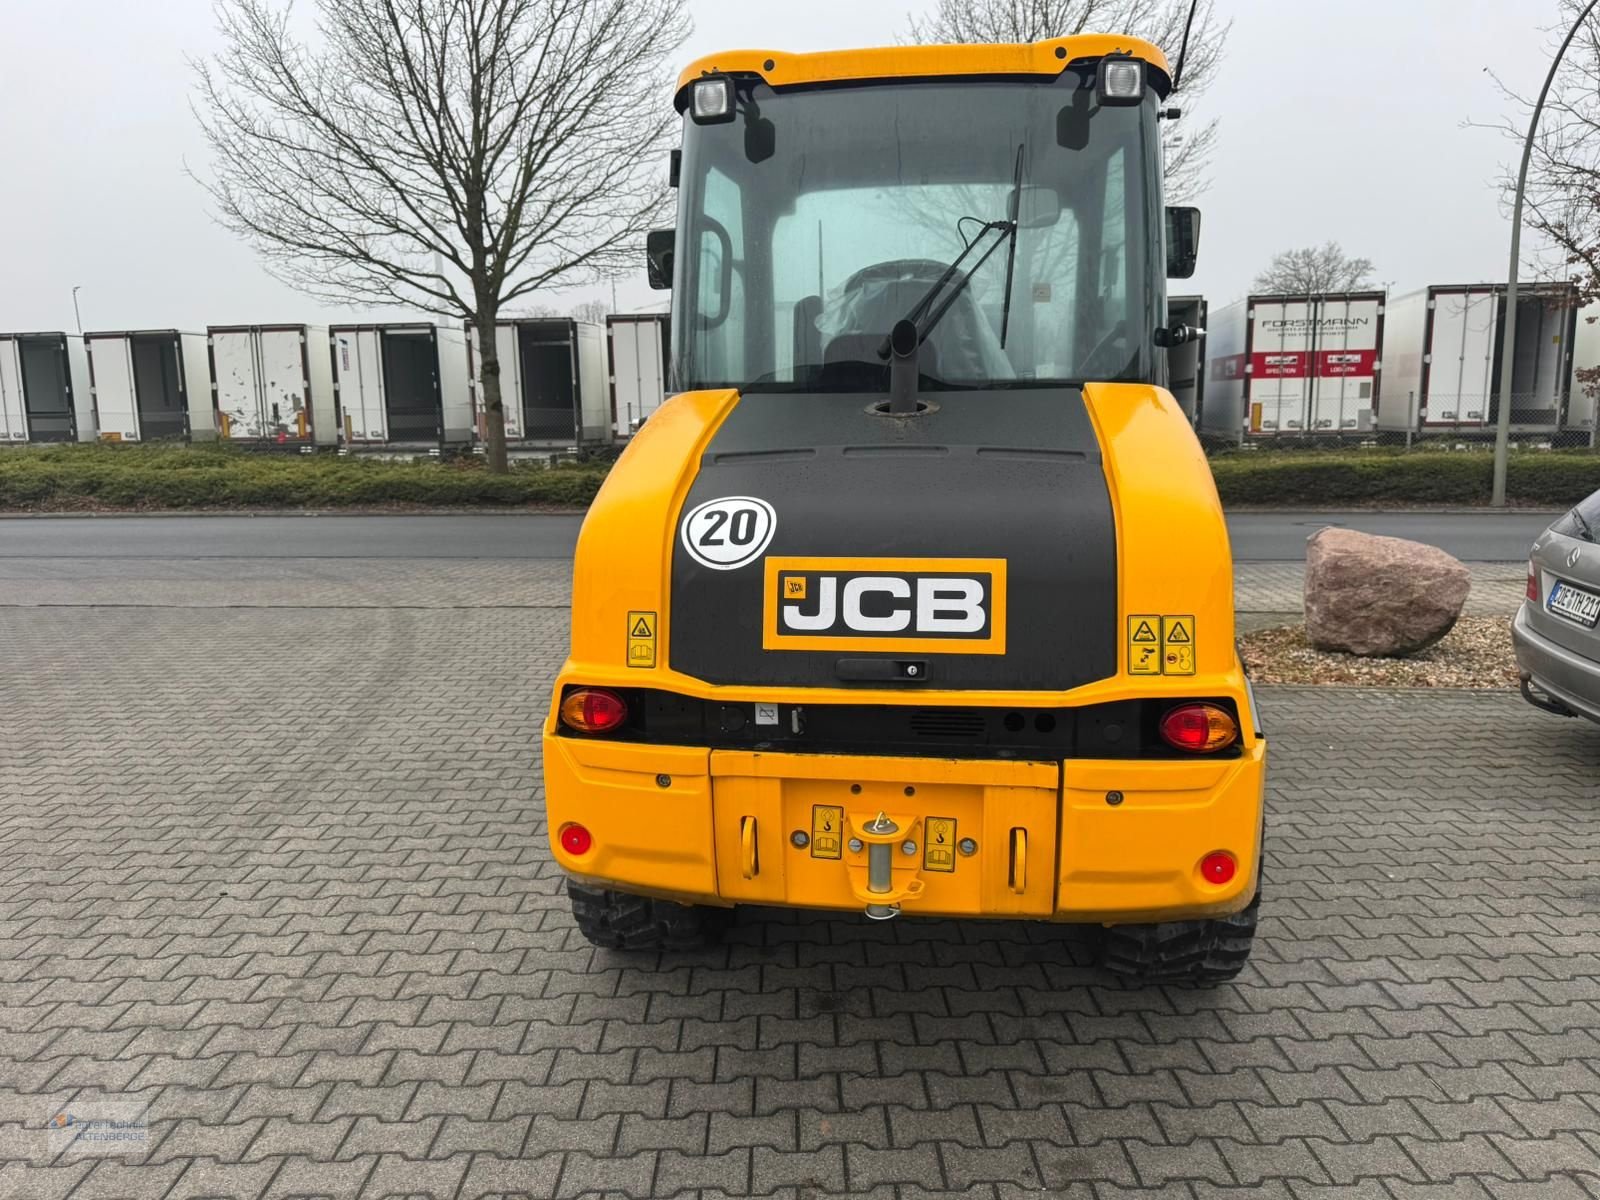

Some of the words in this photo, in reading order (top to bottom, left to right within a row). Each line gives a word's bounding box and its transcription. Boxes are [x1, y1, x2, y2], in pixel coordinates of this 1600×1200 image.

[1262, 318, 1368, 327] FORSTMANN
[699, 508, 758, 546] 20
[783, 576, 986, 632] JCB
